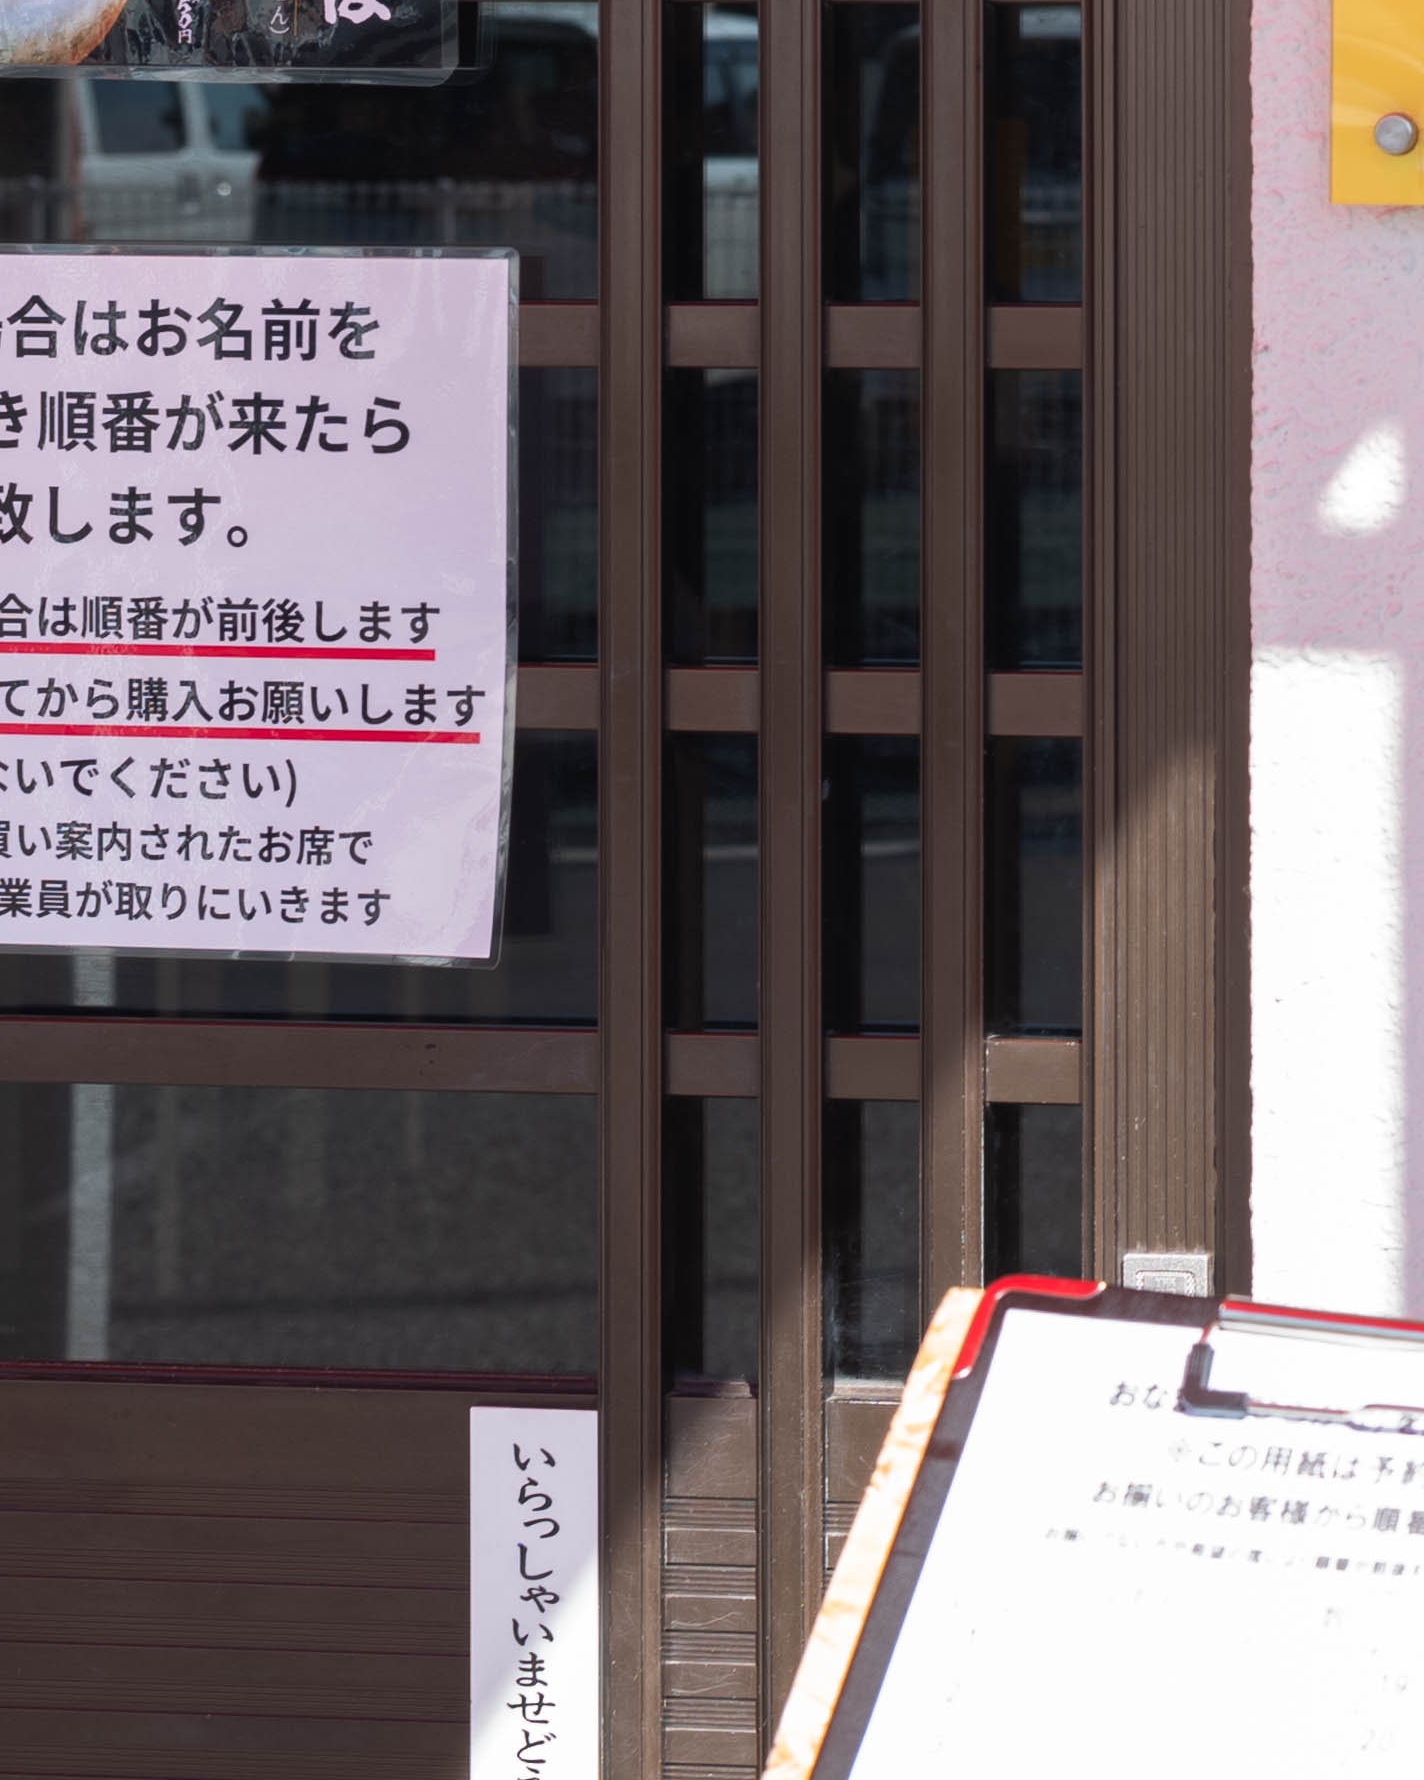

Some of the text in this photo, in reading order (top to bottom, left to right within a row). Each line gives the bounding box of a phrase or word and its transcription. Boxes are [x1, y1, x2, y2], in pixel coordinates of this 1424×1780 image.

[0, 295, 380, 362] 合はお名前を
[0, 594, 441, 644] 合は順番が前後します
[0, 677, 487, 727] てから購入お願いします
[0, 757, 298, 808] いでください)
[0, 877, 391, 926] 業員が取りにいきます
